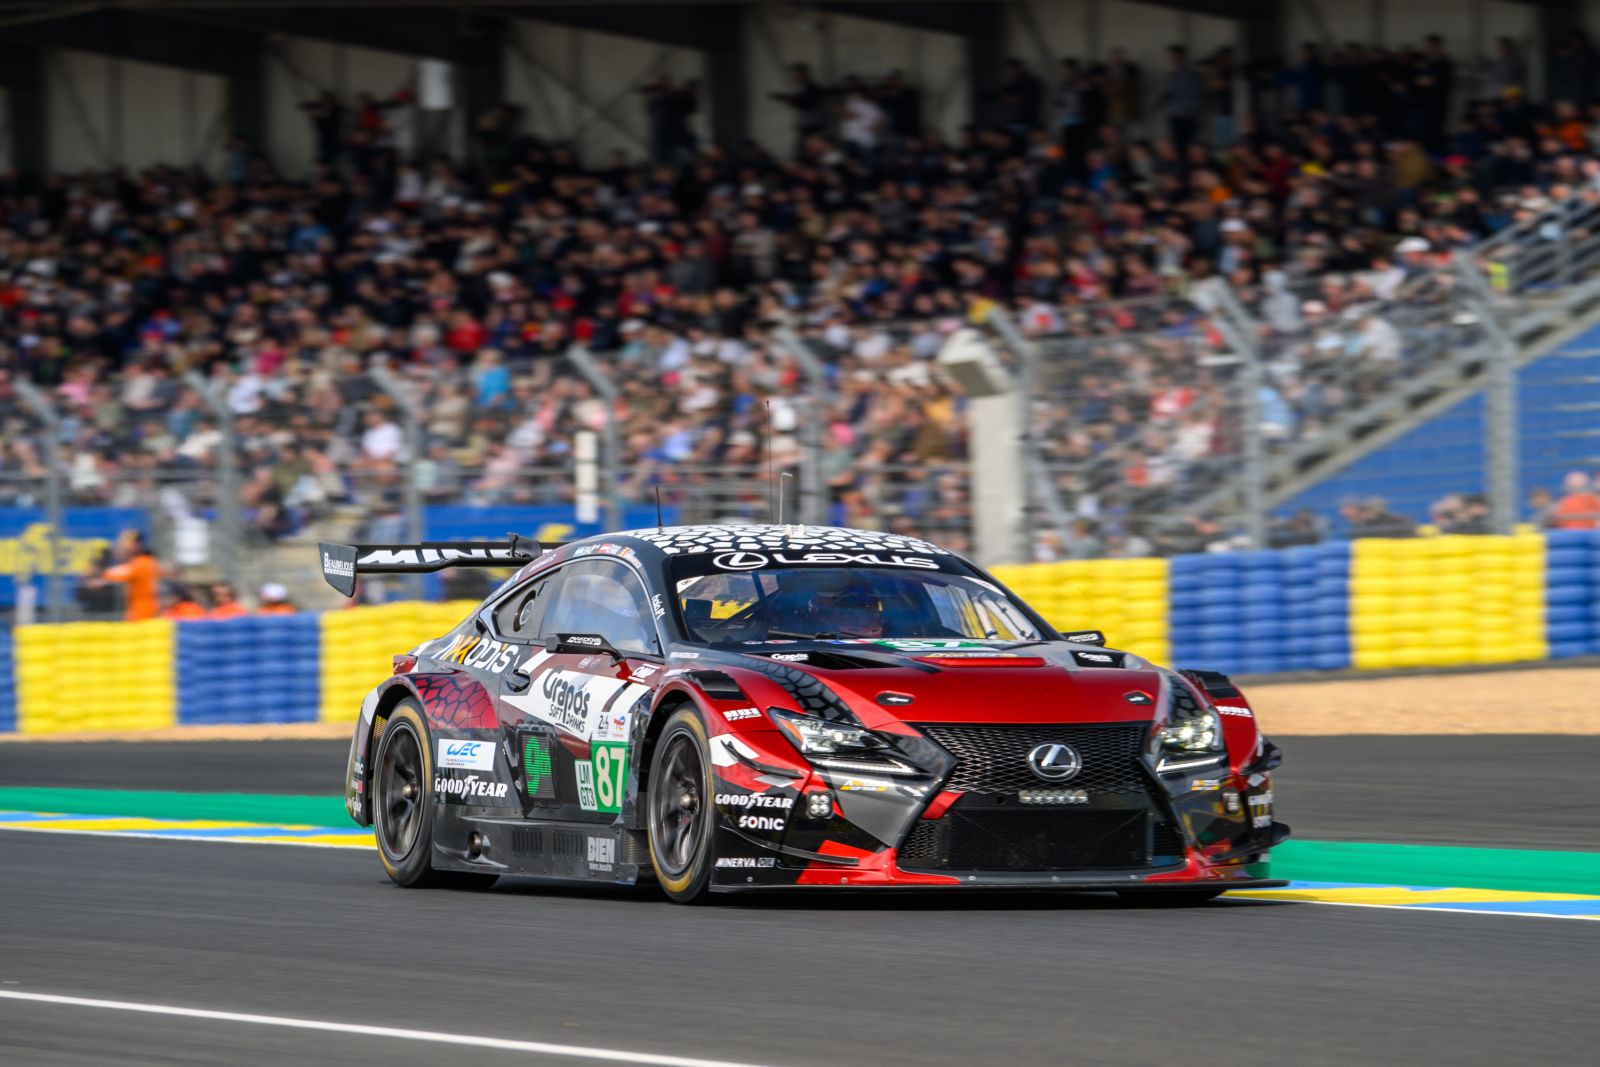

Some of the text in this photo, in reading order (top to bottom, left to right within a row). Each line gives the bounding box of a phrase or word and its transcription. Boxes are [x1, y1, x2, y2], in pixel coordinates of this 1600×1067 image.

[772, 553, 940, 569] LEXUS
[549, 703, 586, 734] SOFT DRINKS
[447, 743, 481, 757] WEC
[578, 764, 590, 784] LM
[596, 746, 626, 808] 87
[434, 775, 508, 800] GOODYEAR
[580, 786, 595, 807] GT3
[715, 792, 794, 809] GOODYEAR
[715, 857, 756, 868] MINERVA
